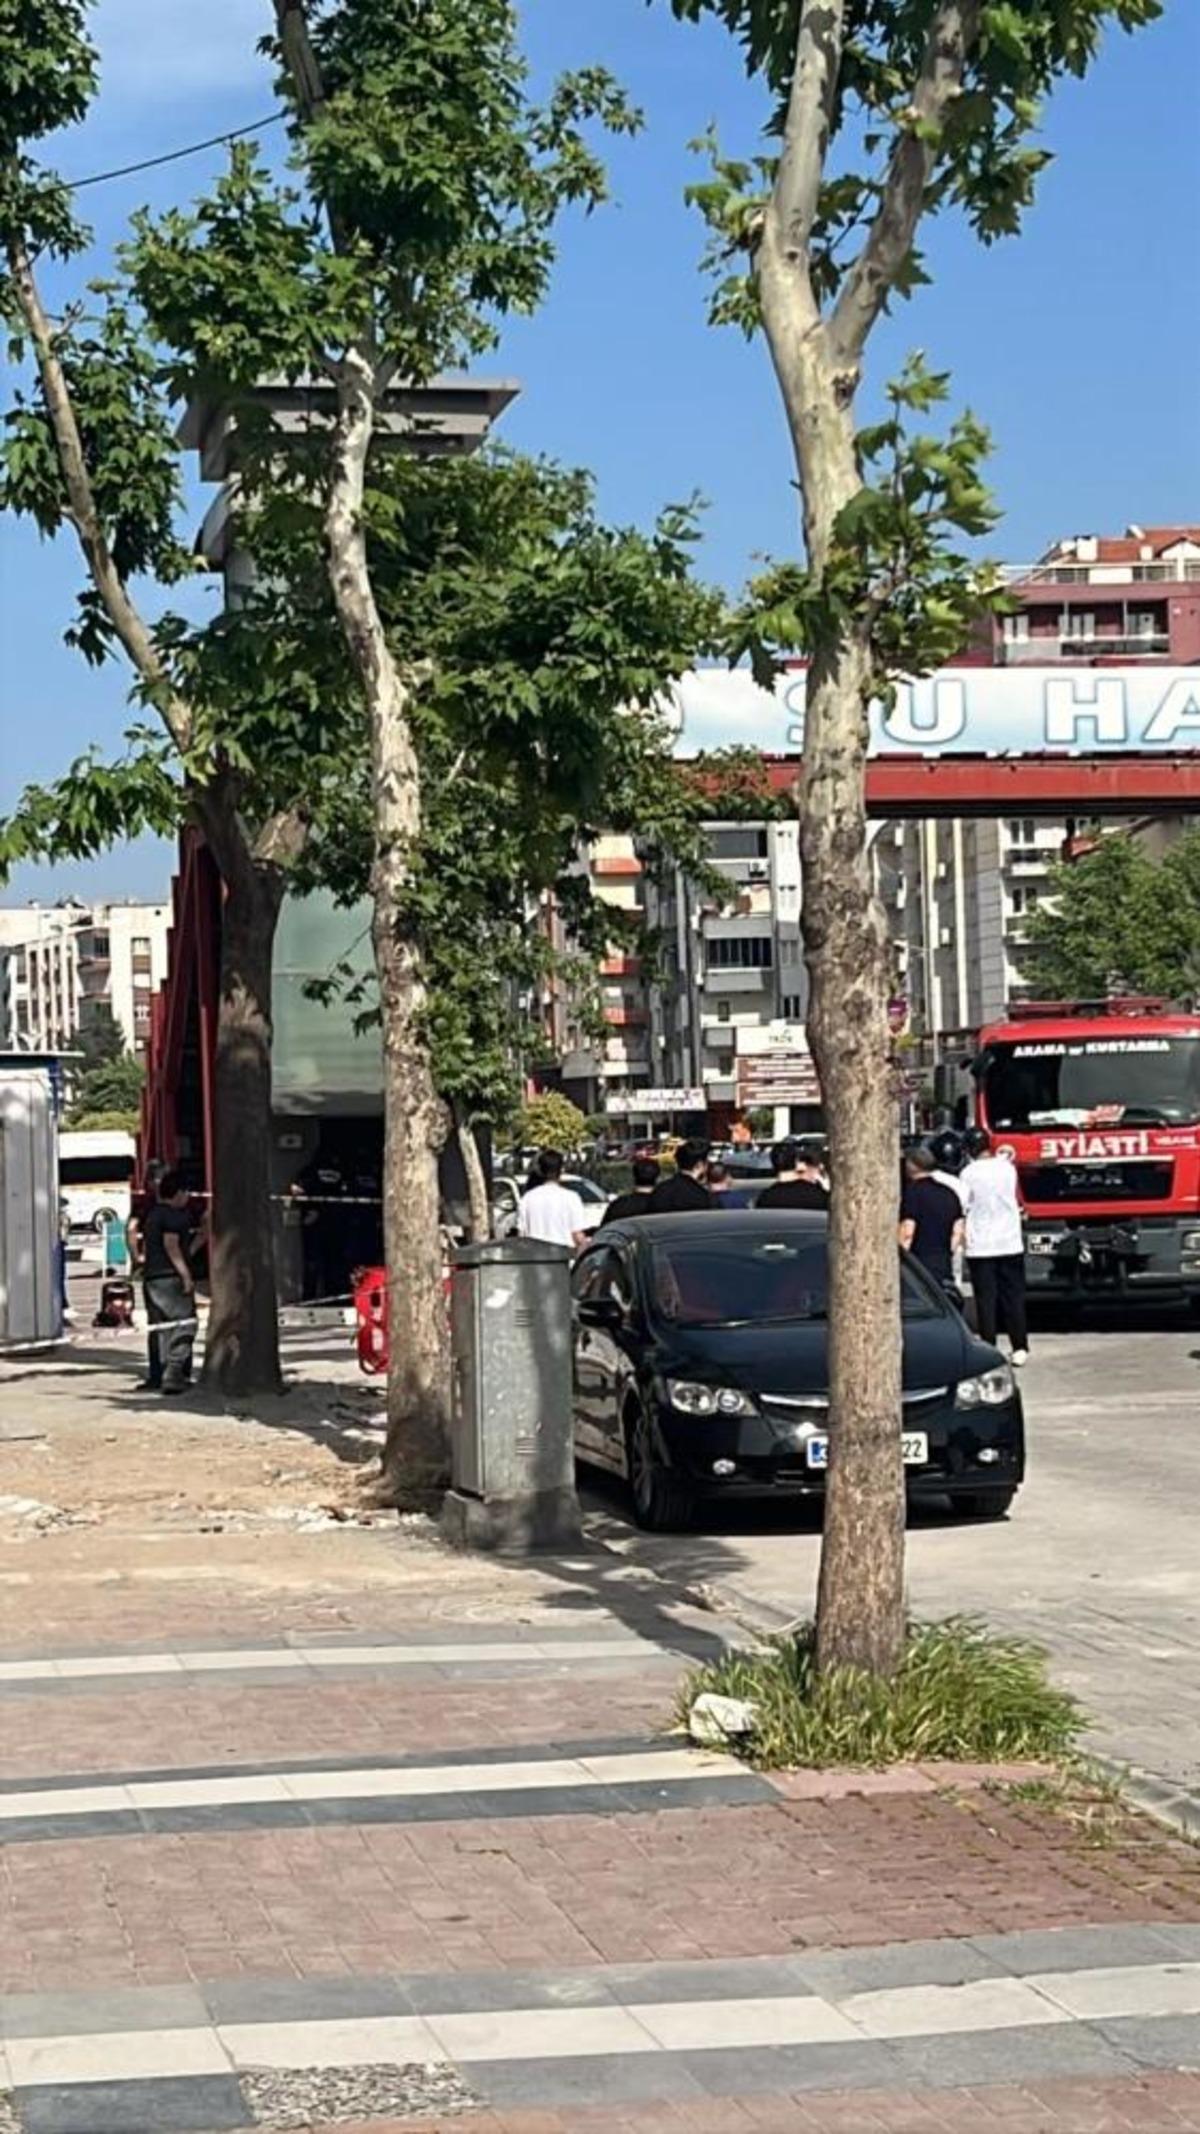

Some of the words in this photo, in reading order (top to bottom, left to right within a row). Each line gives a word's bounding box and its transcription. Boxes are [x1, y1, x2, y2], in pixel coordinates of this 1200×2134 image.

[785, 678, 967, 745] U
[1013, 1043, 1066, 1058] ARAMA
[1085, 1040, 1171, 1054] KURTARMA
